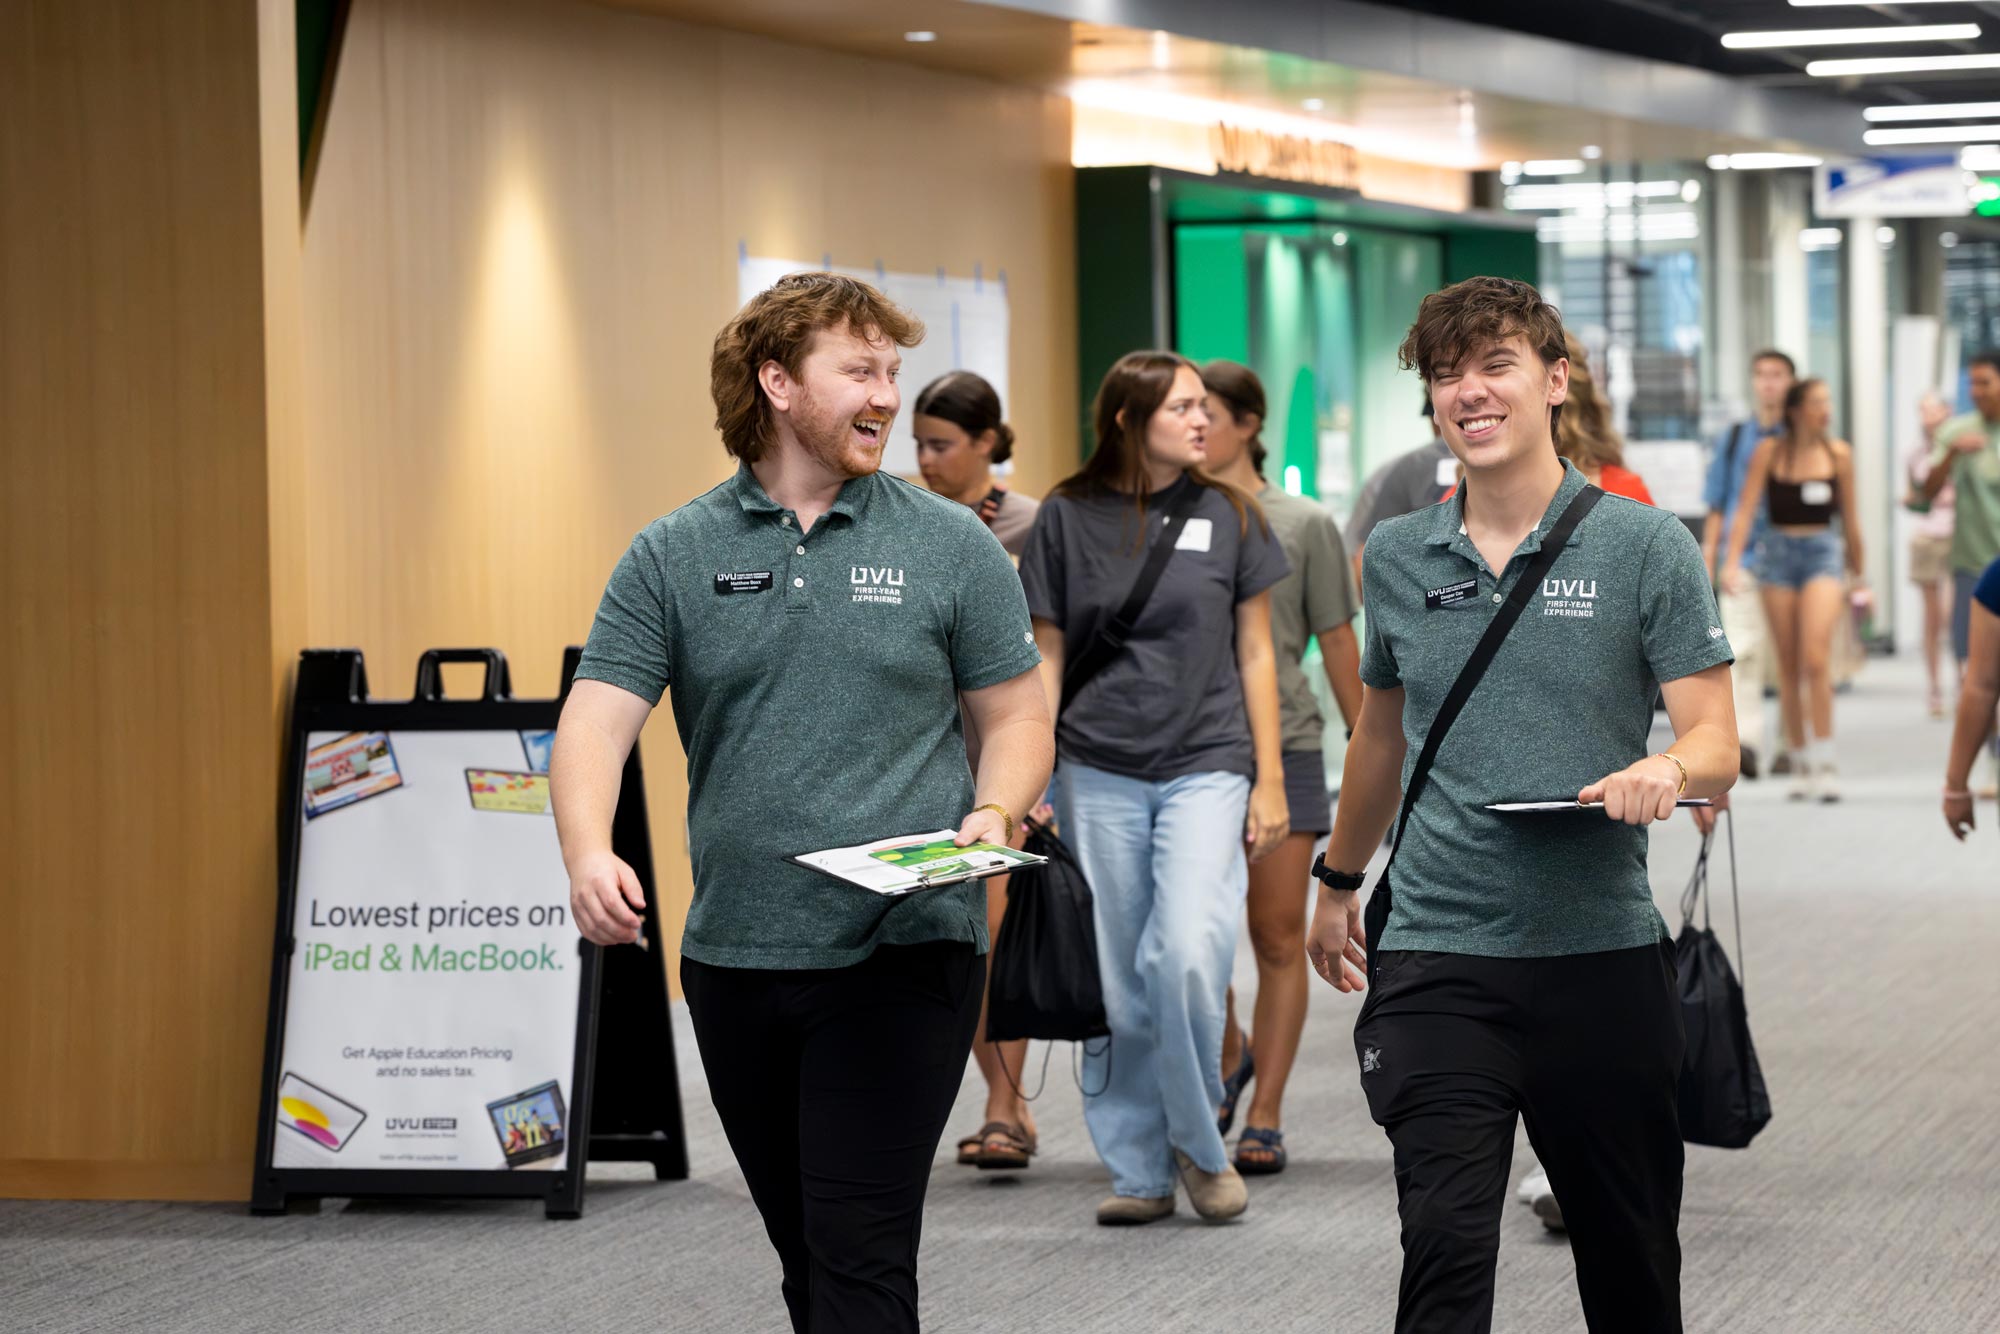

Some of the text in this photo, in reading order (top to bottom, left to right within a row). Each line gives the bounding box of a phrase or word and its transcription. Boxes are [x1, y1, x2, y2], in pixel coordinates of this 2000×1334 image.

[851, 567, 904, 586] UVU
[855, 587, 900, 596] FIRST-YEAR
[1543, 579, 1596, 598] UVU
[852, 595, 902, 604] EXPERIENCE
[1547, 600, 1592, 609] FIRST-YEAR
[1544, 608, 1594, 617] EXPERIENCE
[310, 899, 565, 933] Lowest prices on
[304, 942, 564, 971] iPad & MacBook.
[342, 1047, 513, 1061] Get Apple Education Pricing
[376, 1066, 475, 1077] and no sales tax.
